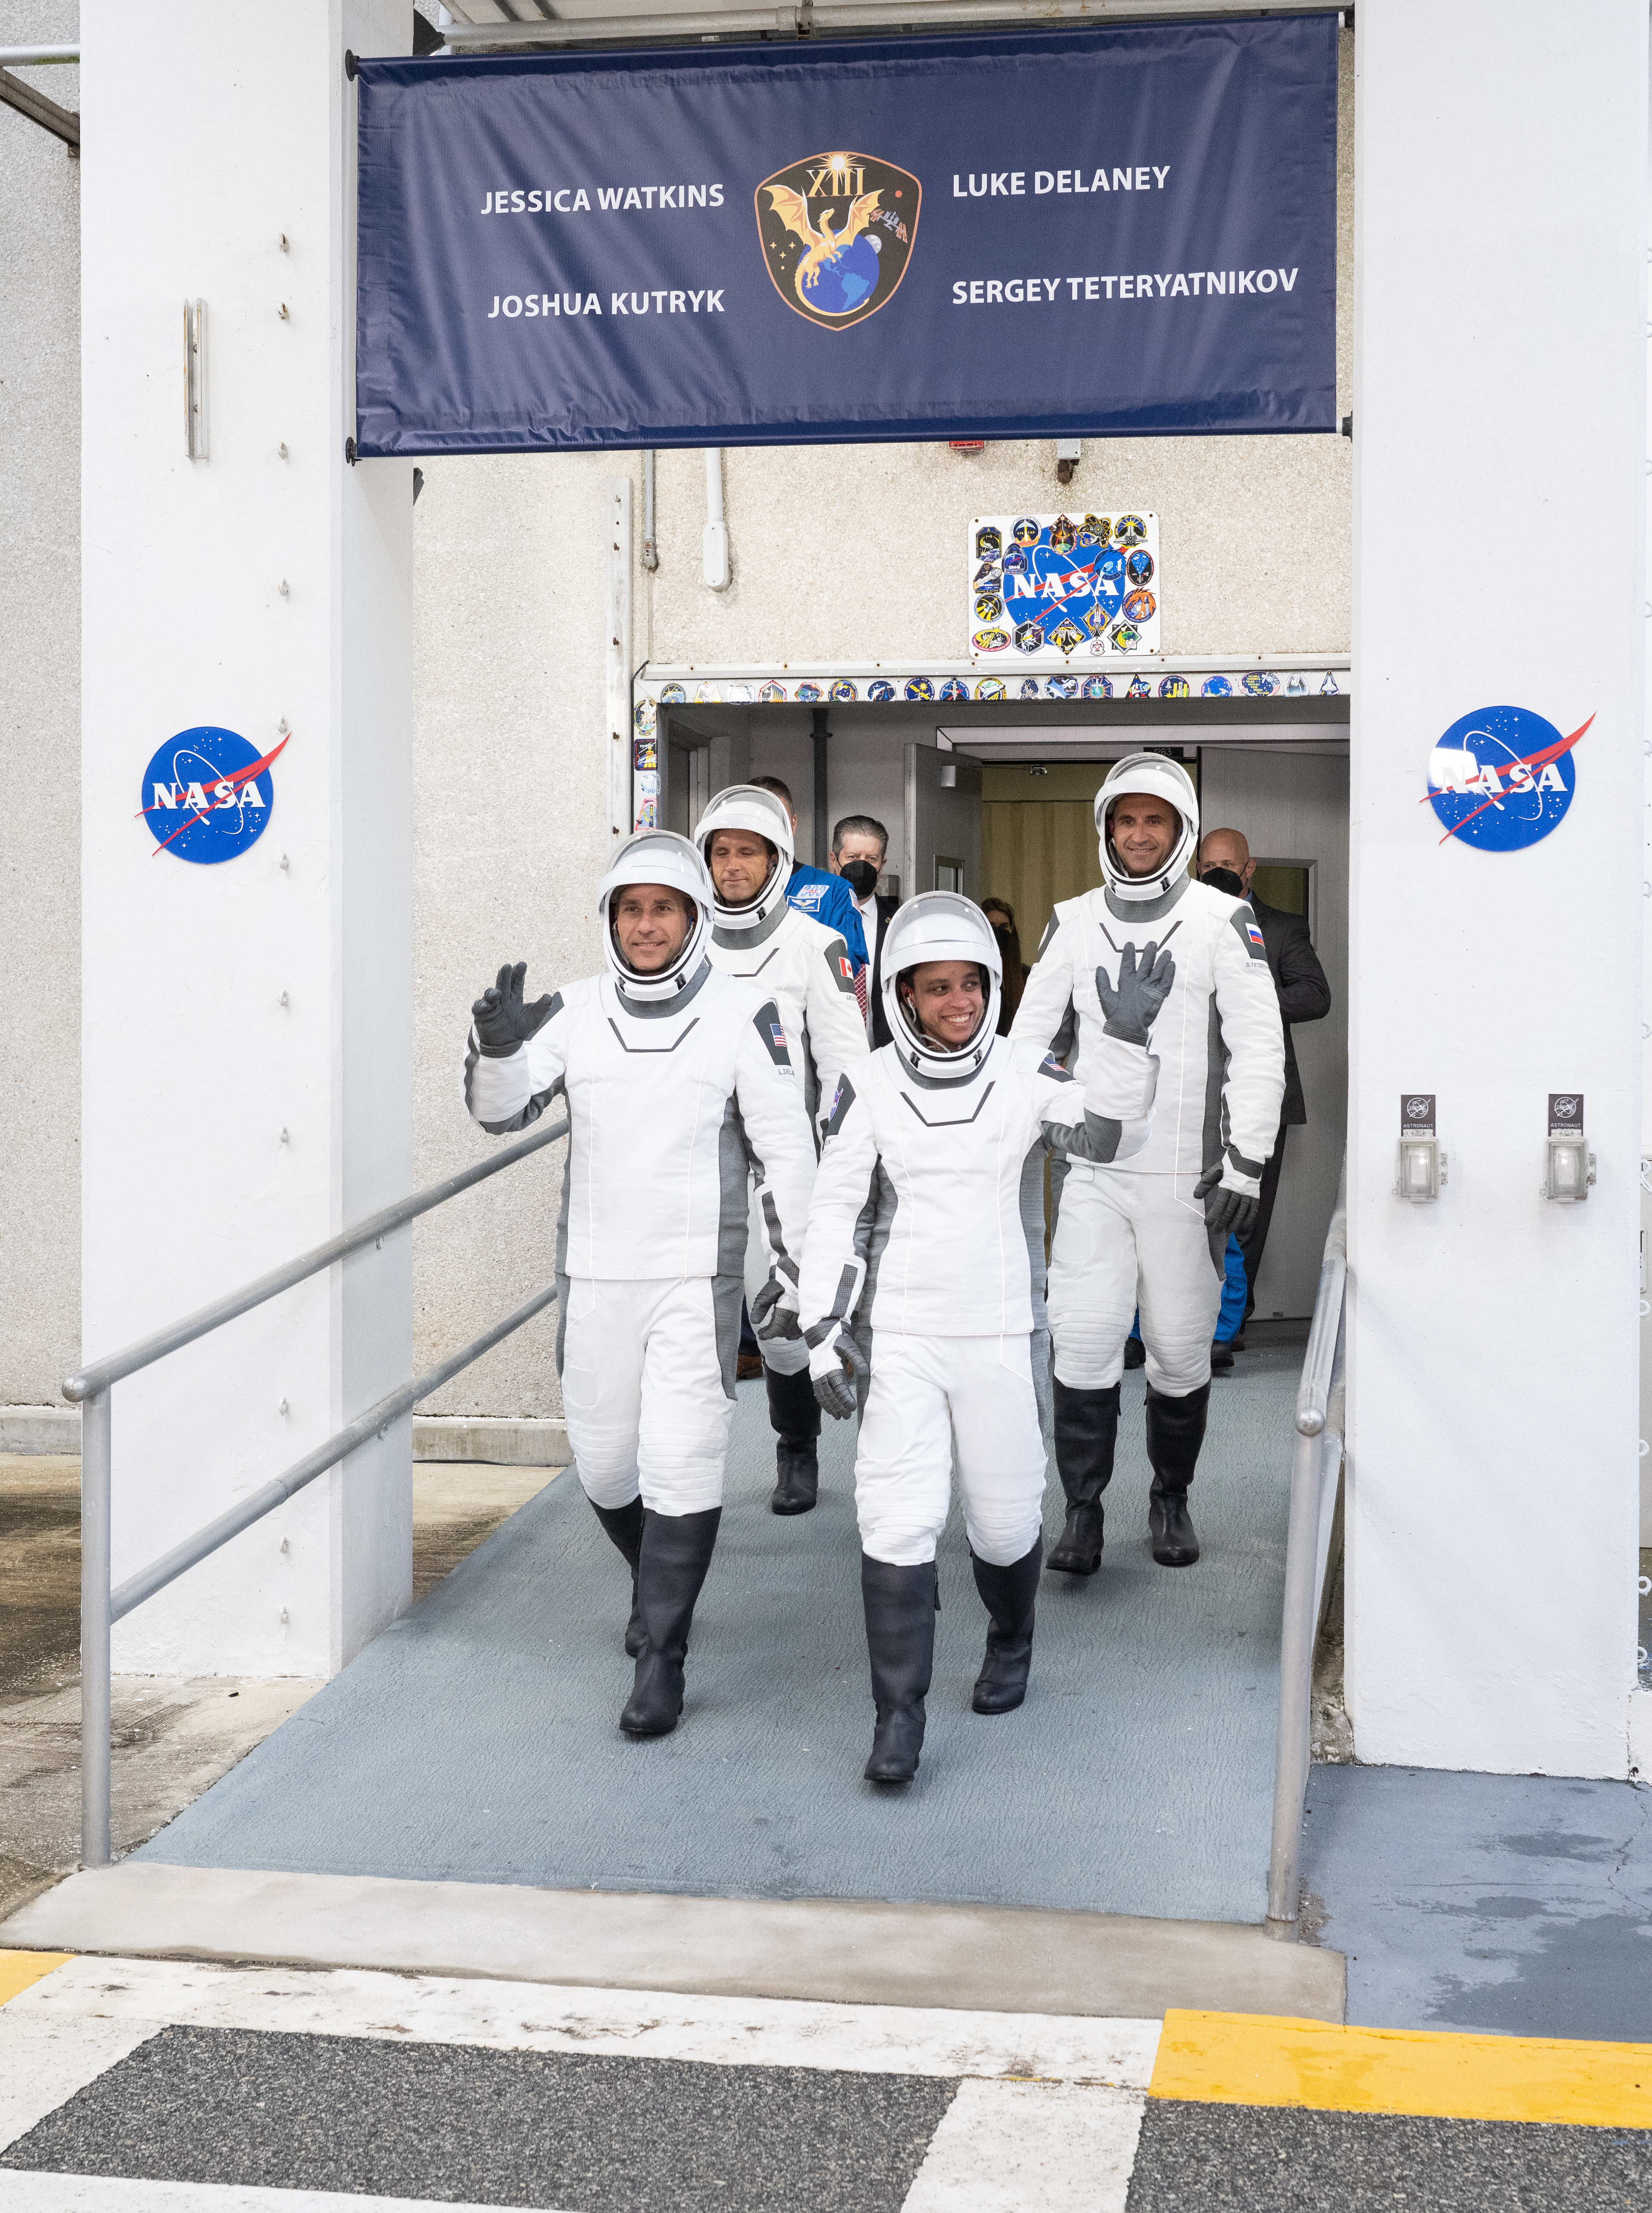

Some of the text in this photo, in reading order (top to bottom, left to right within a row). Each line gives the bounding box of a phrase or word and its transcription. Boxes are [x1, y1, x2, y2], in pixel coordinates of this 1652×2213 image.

[806, 167, 866, 197] XIII
[954, 166, 1171, 197] LUKE DELANEY
[481, 184, 724, 214] JESSICA WATKINS
[953, 268, 1298, 304] SERGEY TETERYATNIKOV
[488, 290, 725, 318] JOSHUA KUTRYK
[1117, 558, 1122, 571] 1
[1013, 572, 1119, 598] NASA
[1439, 763, 1568, 794] NASA
[152, 781, 266, 809] NASA
